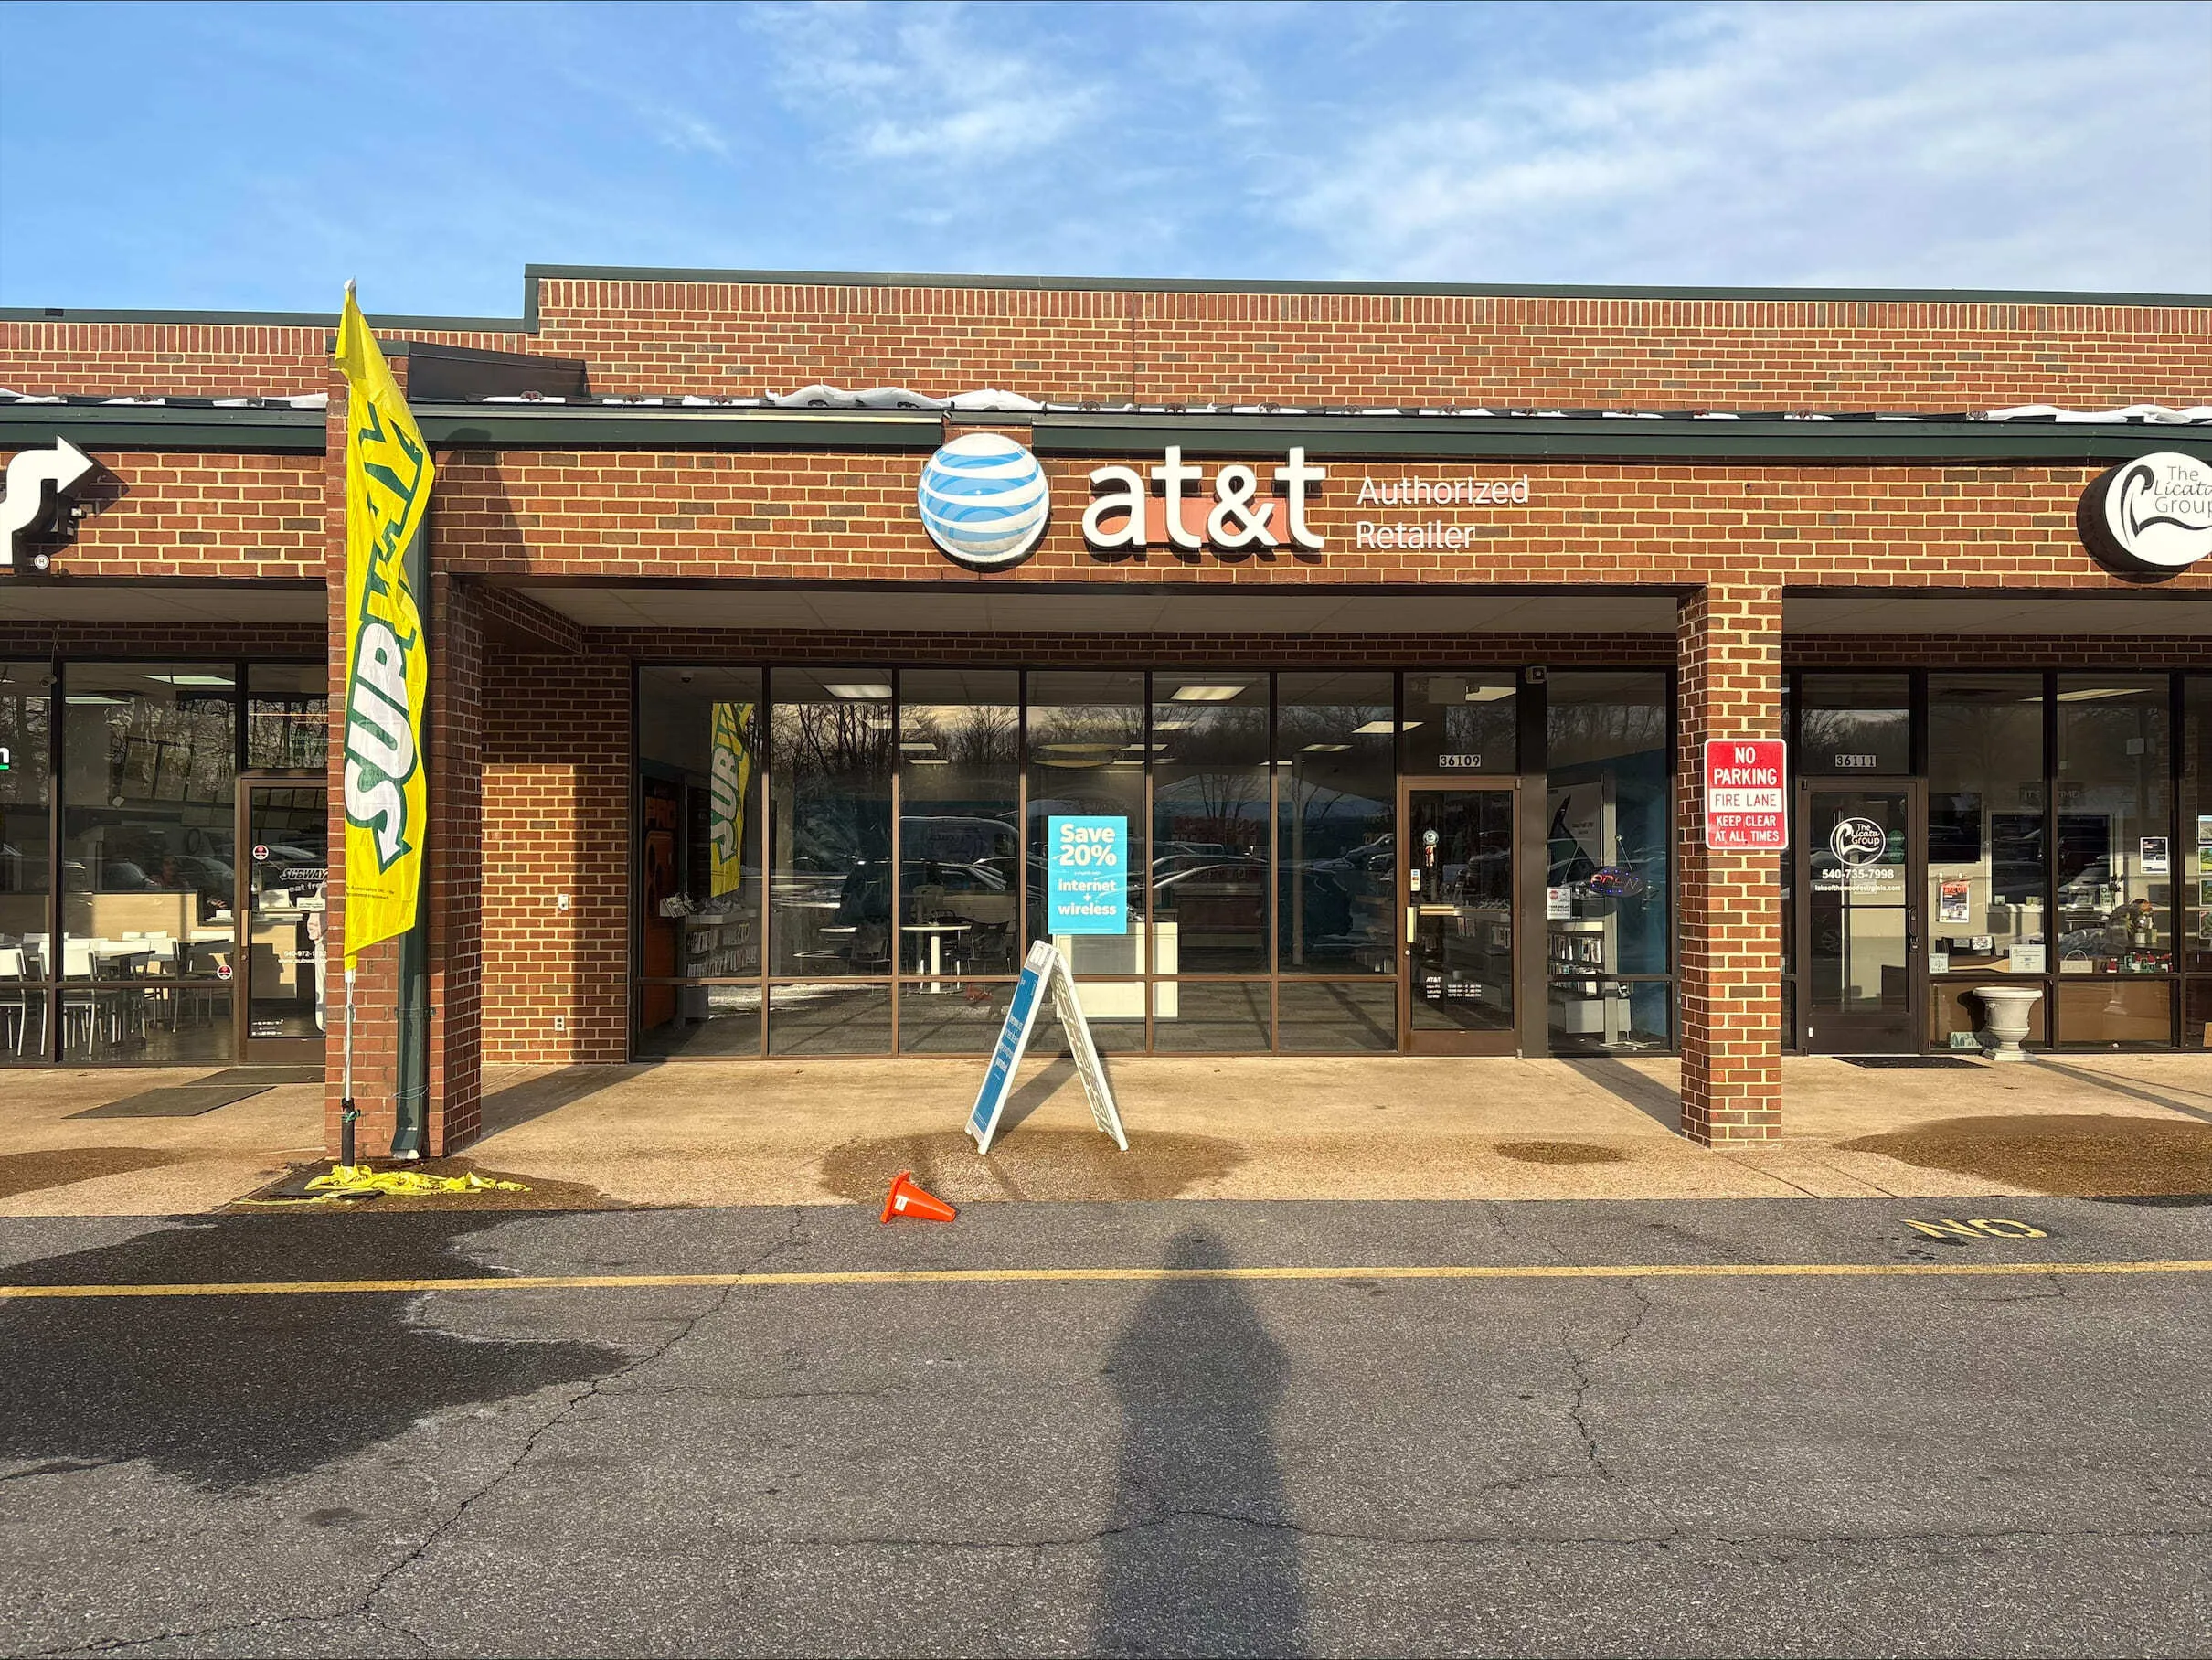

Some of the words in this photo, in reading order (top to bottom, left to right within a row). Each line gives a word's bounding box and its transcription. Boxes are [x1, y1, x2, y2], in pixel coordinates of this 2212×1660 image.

[2167, 465, 2199, 481] The
[1082, 445, 1325, 548] at&t
[1356, 474, 1529, 505] Authorized
[1356, 520, 1476, 549] Retailer
[1441, 756, 1480, 766] 36109
[1734, 747, 1756, 764] NO
[1836, 756, 1875, 766] 36111
[1714, 768, 1777, 785] PARKING
[1715, 793, 1740, 806] FIRE
[1746, 793, 1777, 806] LANE
[1716, 815, 1741, 826] KEEP
[1745, 815, 1776, 826] CLEAR
[1060, 824, 1115, 843] Save
[1715, 831, 1726, 842] AT
[1729, 831, 1747, 842] ALL
[1750, 831, 1780, 842] TIMES
[1851, 836, 1880, 846] Group
[1059, 844, 1117, 866] 20%
[1822, 869, 1895, 879] 540-735-7998
[1058, 878, 1117, 891] internet
[1058, 902, 1117, 915] wireless
[1898, 1218, 2048, 1239] NO
